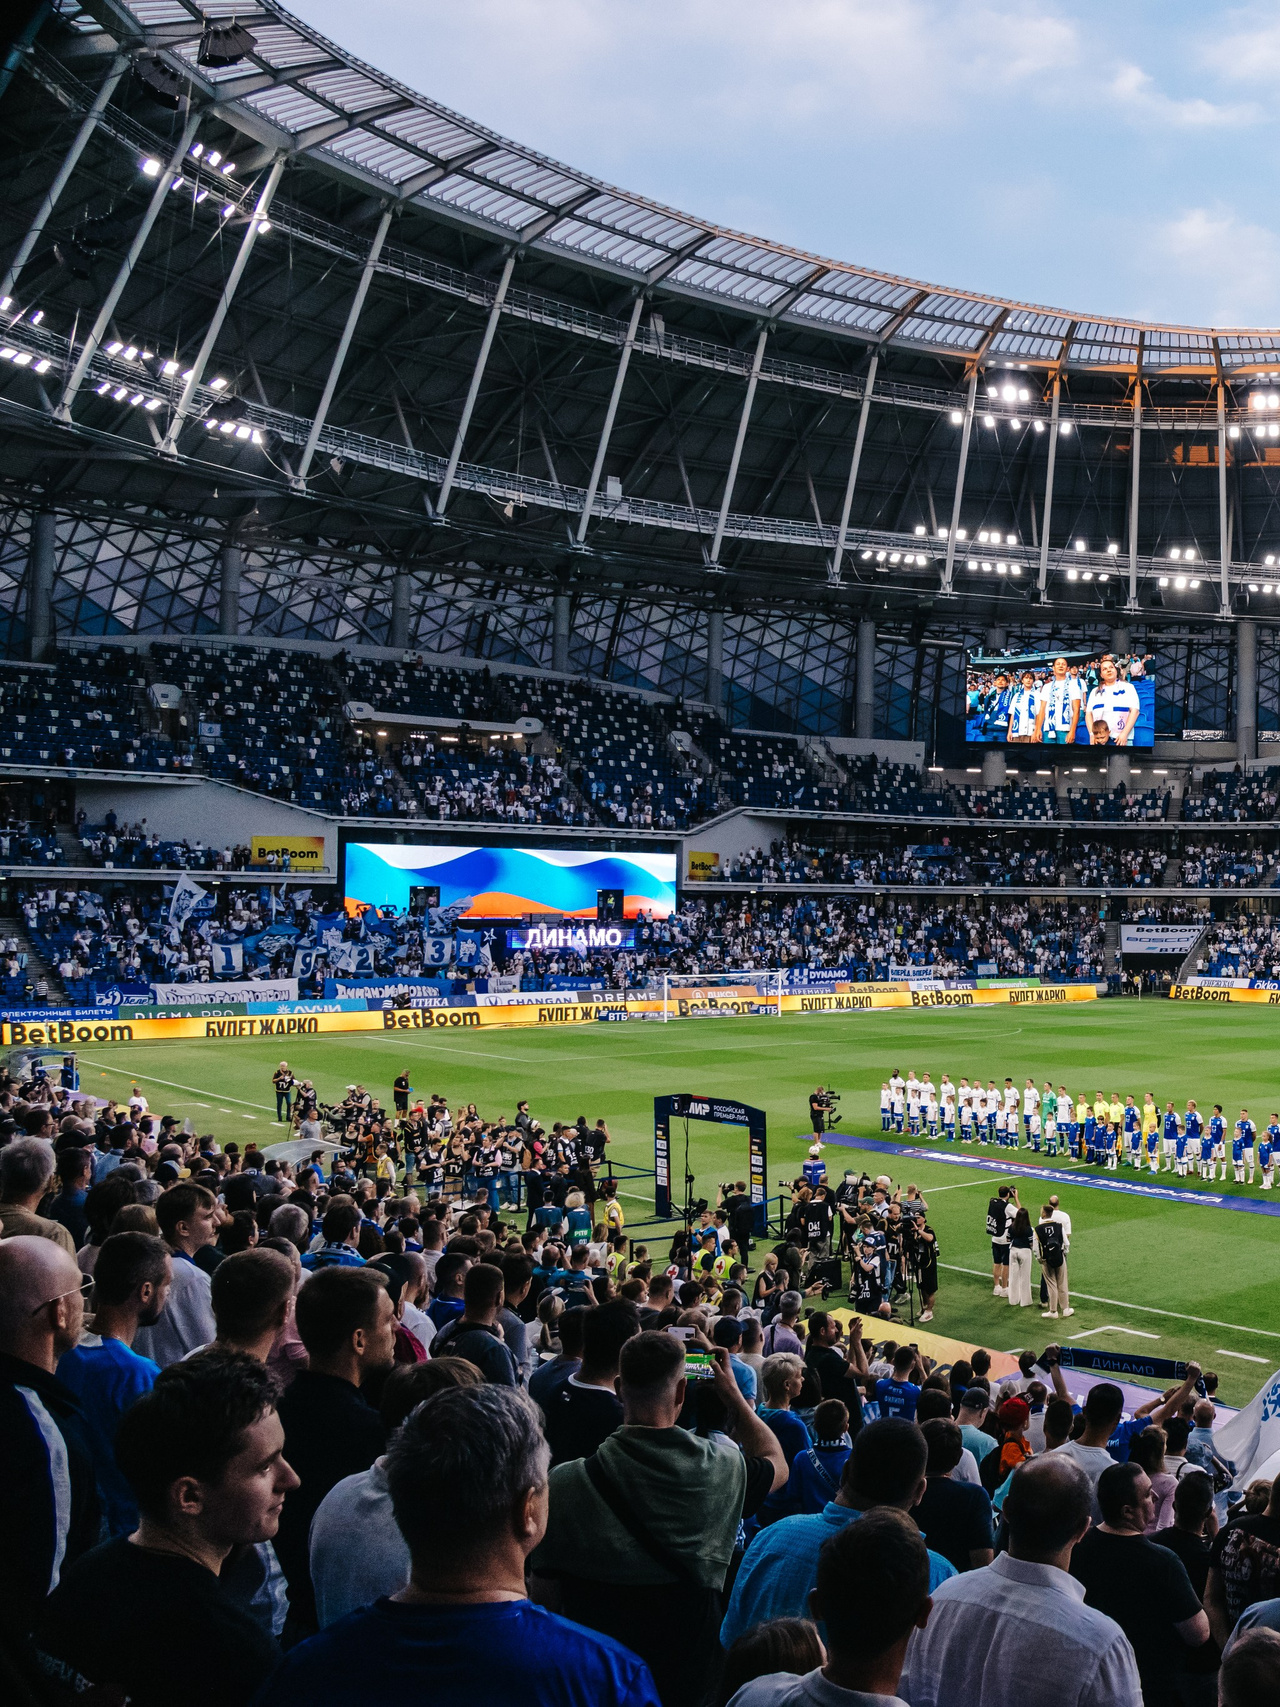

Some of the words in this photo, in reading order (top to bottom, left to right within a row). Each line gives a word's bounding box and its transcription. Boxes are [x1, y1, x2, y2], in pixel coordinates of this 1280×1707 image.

[525, 928, 622, 948] ДИНАМО
[221, 947, 236, 971] 1
[357, 947, 372, 970] 2
[431, 941, 445, 962] 3
[809, 970, 848, 979] DYNAMO
[592, 992, 657, 1003] DREAME
[911, 990, 973, 1006] BetBoom
[1174, 985, 1231, 1001] BetBoom
[507, 997, 572, 1005] CHANGAN
[1, 1009, 72, 1018] ЭЛЕКТРОННЫЕ
[759, 1006, 777, 1014] ВТБ
[383, 1009, 480, 1029] BetBoom
[608, 1012, 628, 1021] ВТБ
[11, 1022, 133, 1044] BetBoom
[713, 1105, 745, 1115] РОССИЙСКАЯ
[713, 1111, 749, 1122] ПРЕМЬЕР-ЛИГА
[449, 1164, 461, 1173] TV
[1092, 1357, 1155, 1376] ДИНАМО
